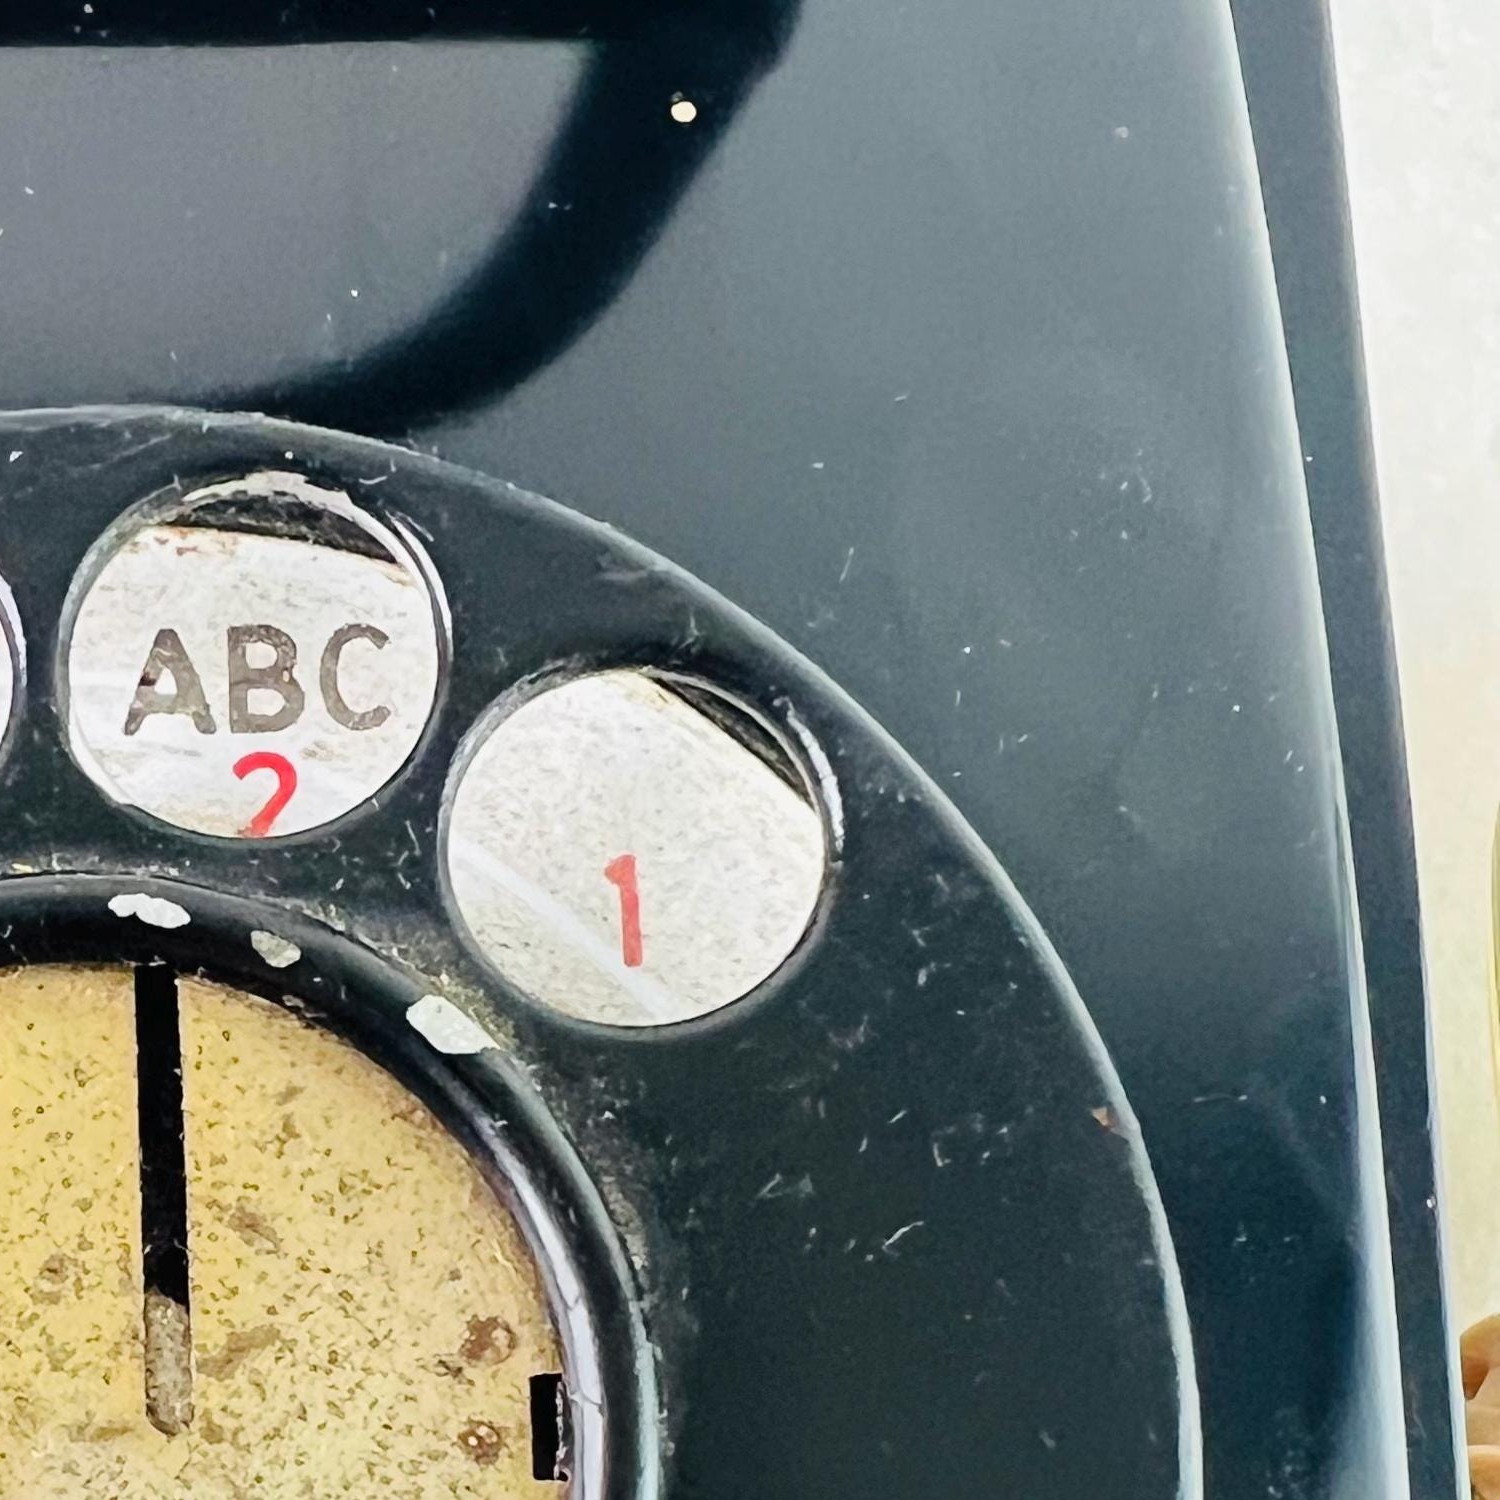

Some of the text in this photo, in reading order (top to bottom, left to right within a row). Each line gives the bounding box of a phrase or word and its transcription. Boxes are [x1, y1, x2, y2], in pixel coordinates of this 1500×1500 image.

[124, 622, 389, 737] ABC
[233, 752, 298, 837] 2
[606, 856, 641, 966] 1
